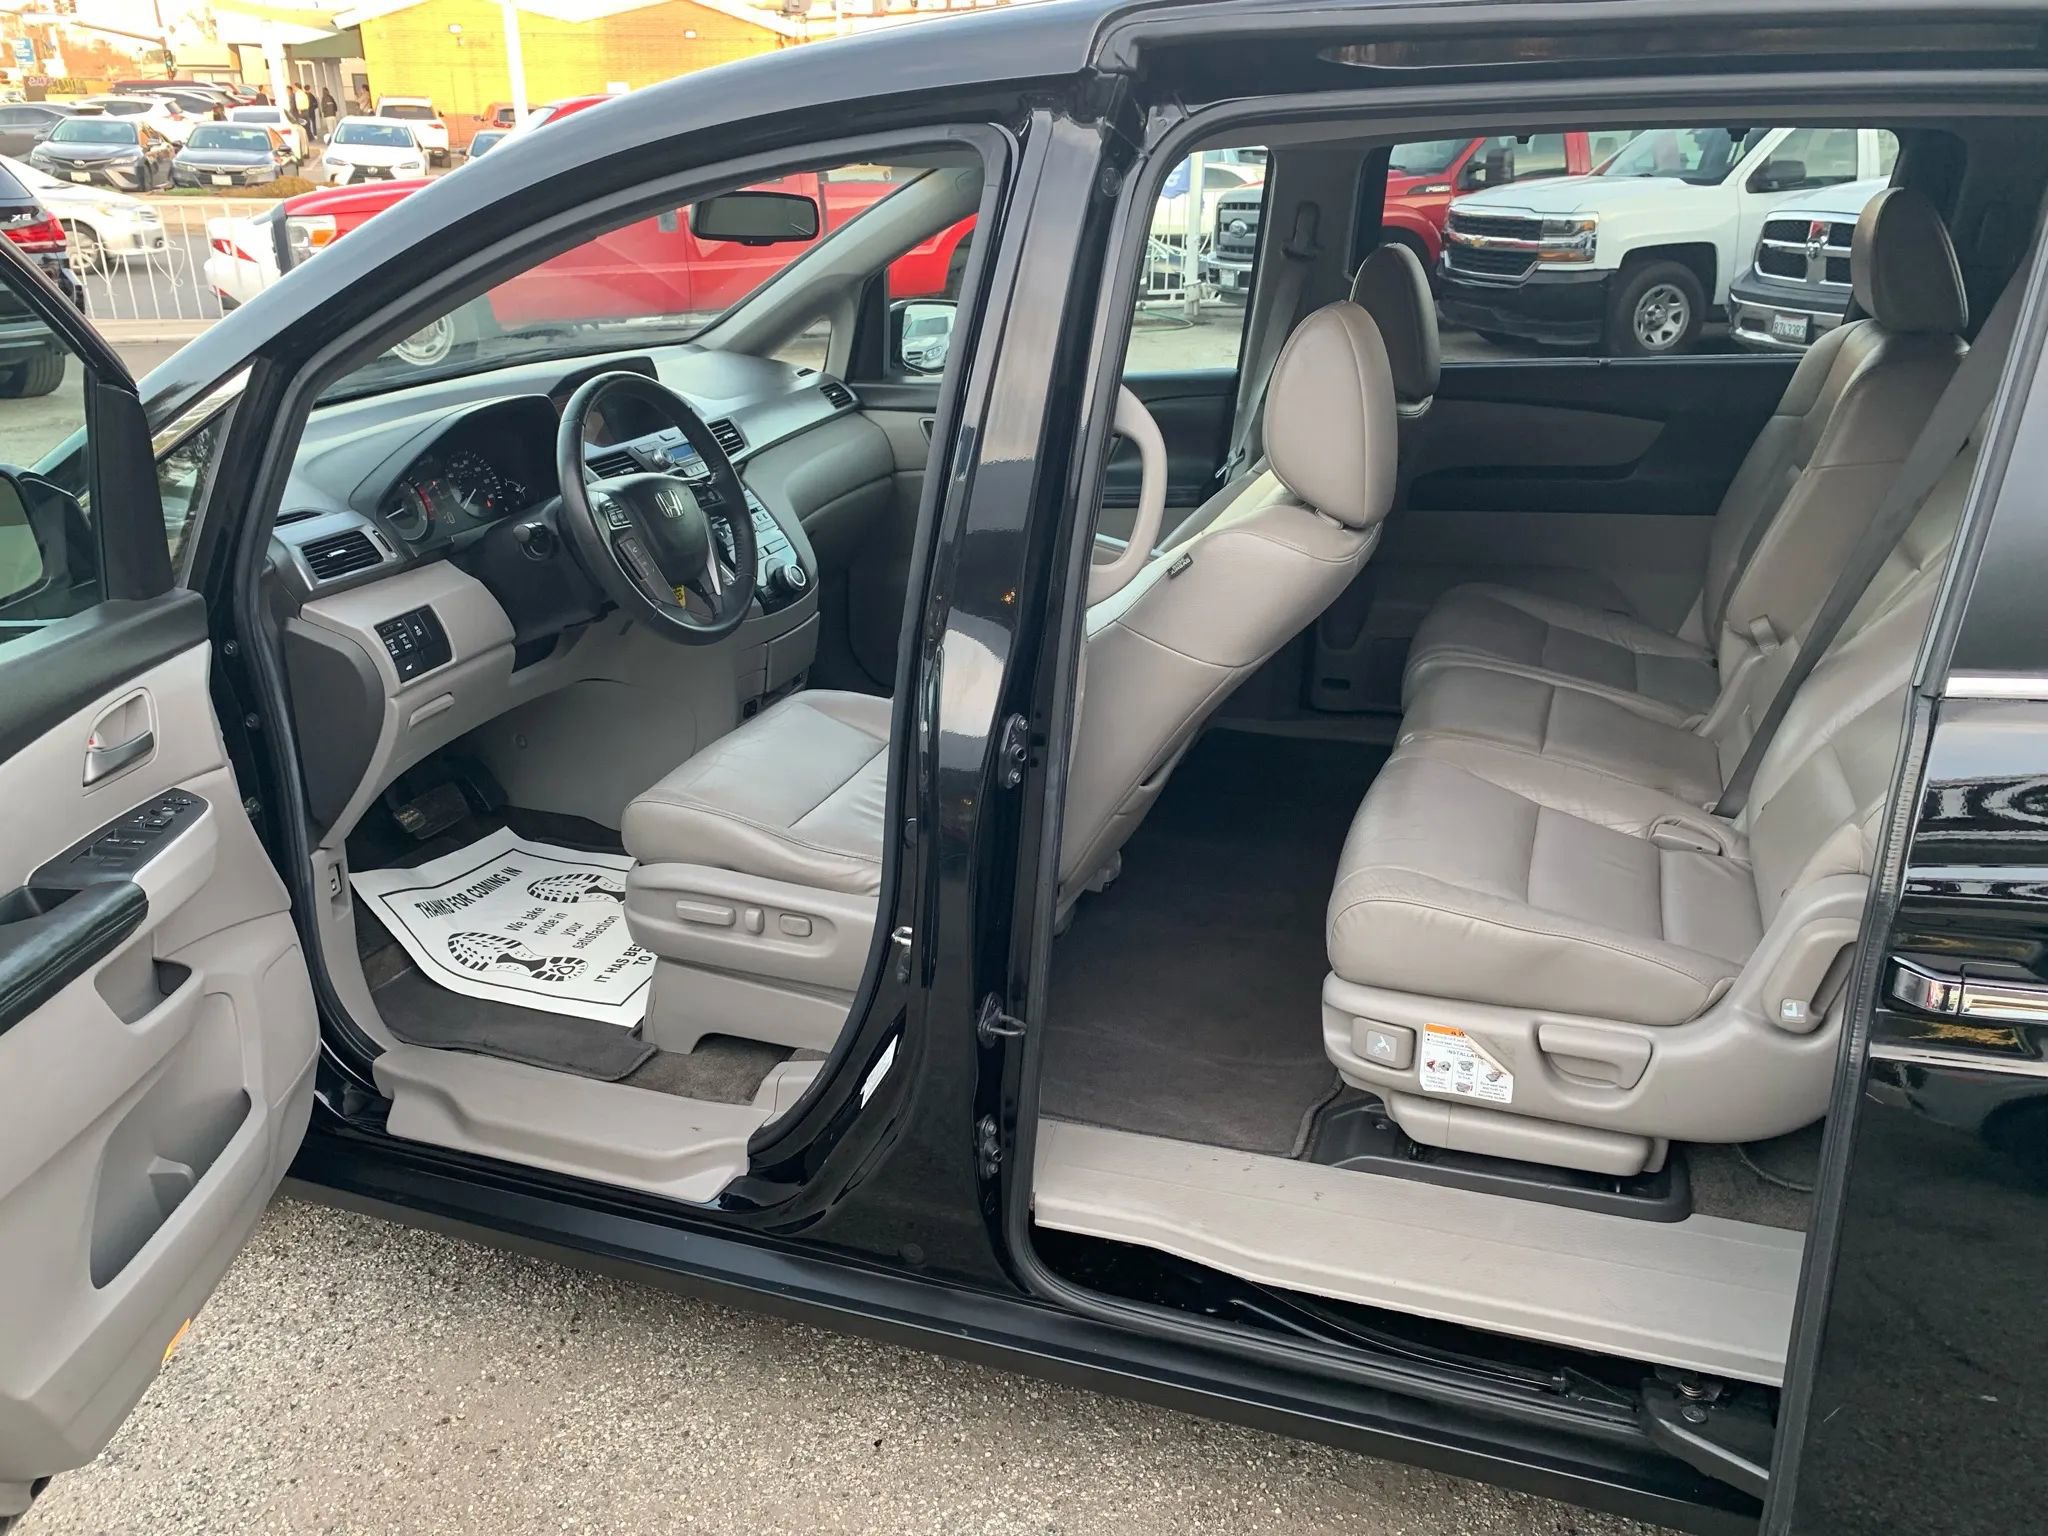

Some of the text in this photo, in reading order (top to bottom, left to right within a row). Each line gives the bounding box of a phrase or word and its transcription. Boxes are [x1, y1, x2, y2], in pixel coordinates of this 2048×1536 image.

[414, 866, 523, 919] THANKS FOR COMING IN
[504, 907, 546, 932] We take
[533, 912, 568, 936] pride in
[560, 922, 584, 937] your
[572, 915, 620, 949] satisfaction
[593, 974, 611, 983] IT
[604, 958, 630, 974] HAS
[632, 955, 653, 966] TO
